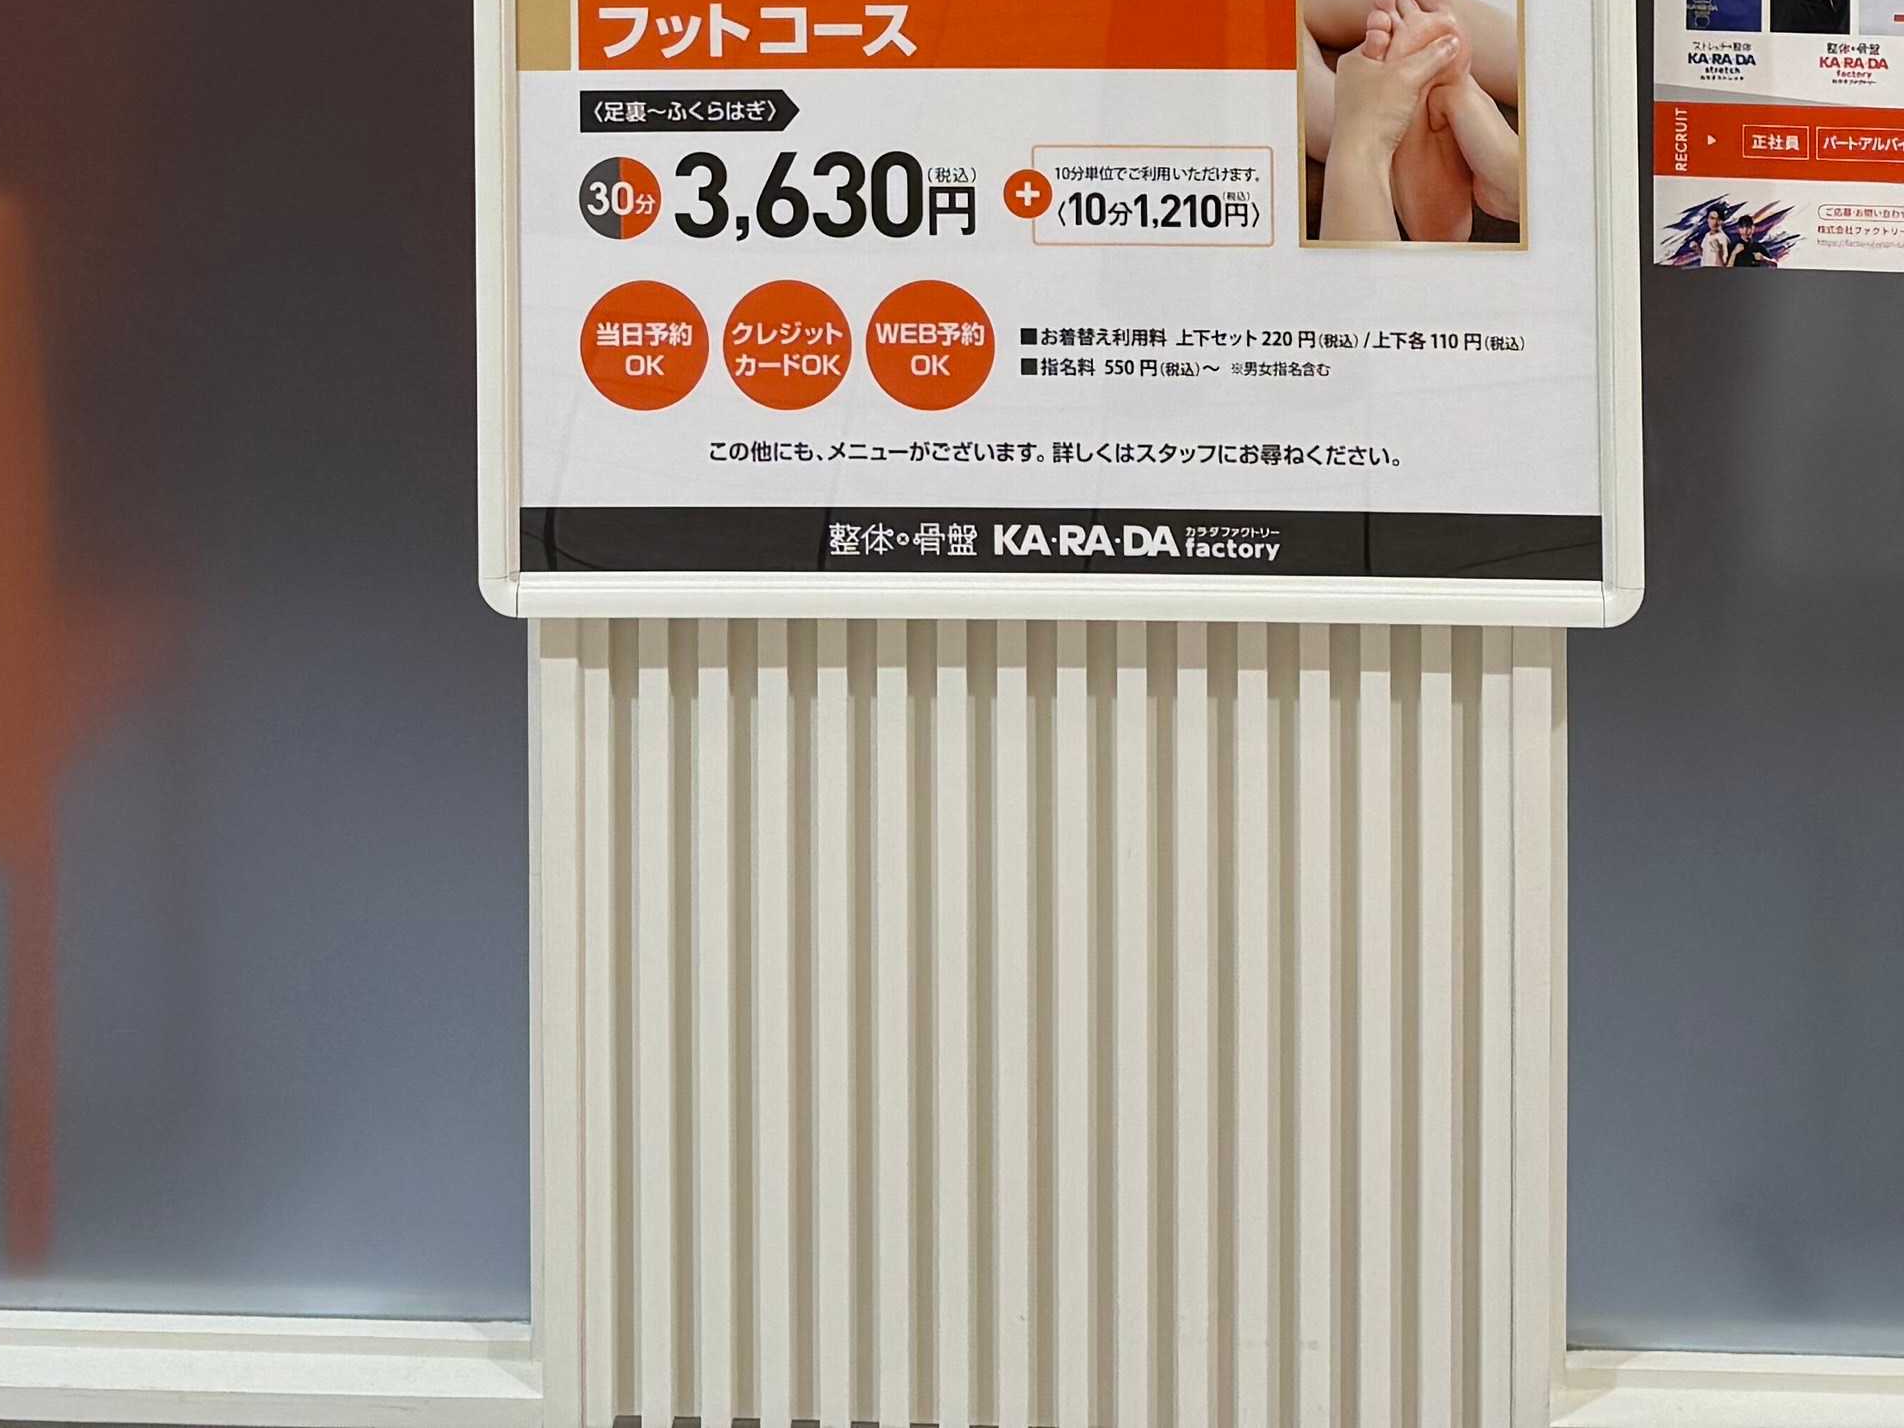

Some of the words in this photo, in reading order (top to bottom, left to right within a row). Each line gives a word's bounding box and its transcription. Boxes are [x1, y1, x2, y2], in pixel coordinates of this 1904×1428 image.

[599, 4, 917, 58] フットコース
[1705, 66, 1740, 74] stretch
[1836, 70, 1872, 79] factory
[1675, 108, 1688, 172] RECRUIT
[1752, 135, 1800, 152] 正社員
[1055, 167, 1259, 184] 10分単位でご利用いただけます。
[586, 180, 655, 214] 30分
[675, 151, 976, 242] 3,630円
[597, 322, 692, 346] 当日予約
[732, 322, 842, 344] クレジット
[876, 322, 984, 346] WEB予約
[626, 355, 664, 375] OK
[736, 354, 840, 376] カードOK
[911, 355, 949, 375] OK
[1186, 538, 1280, 561] factory
